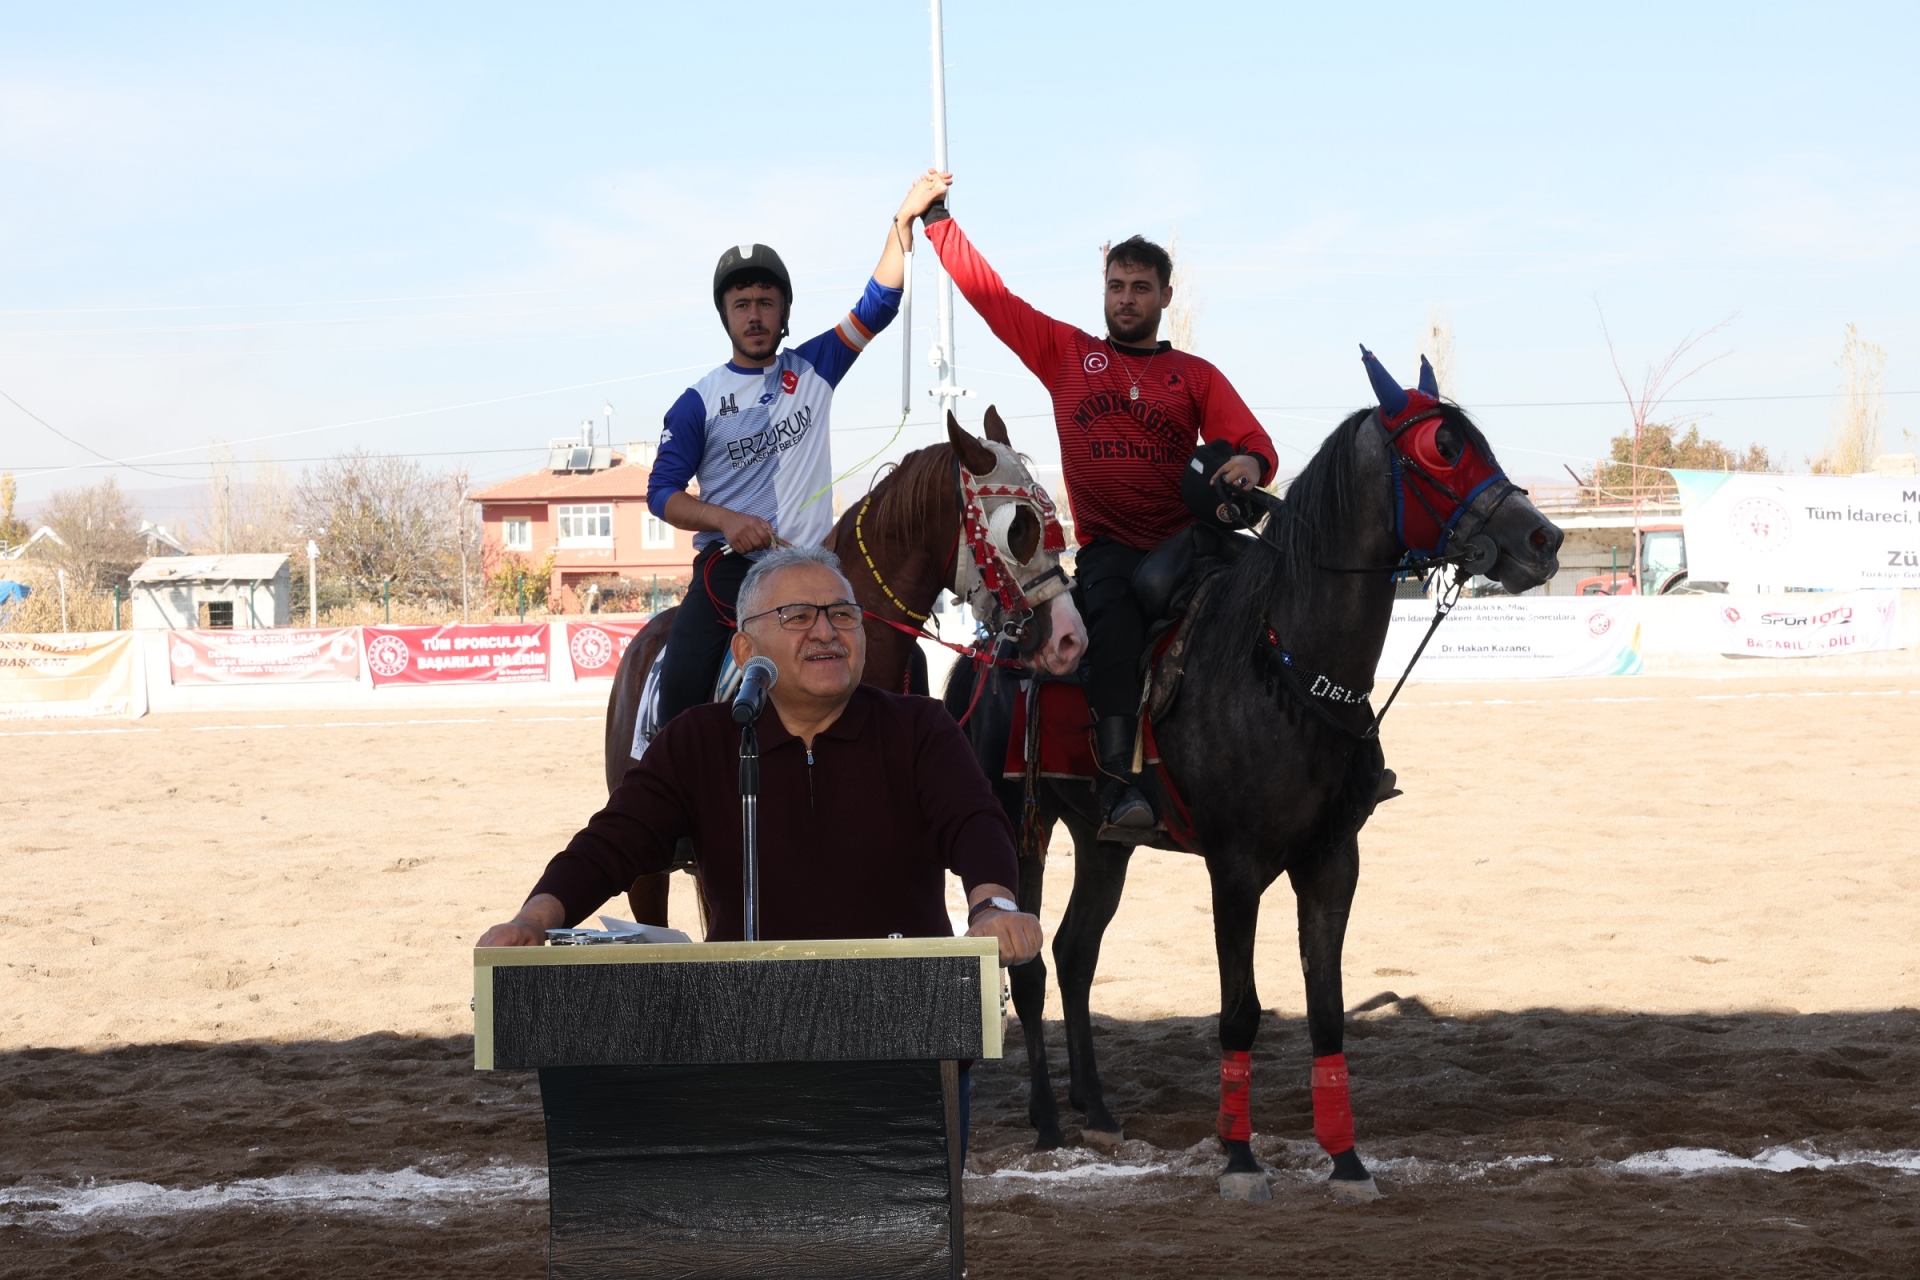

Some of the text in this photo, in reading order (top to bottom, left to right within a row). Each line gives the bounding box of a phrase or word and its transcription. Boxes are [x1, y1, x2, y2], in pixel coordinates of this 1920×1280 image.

[727, 405, 812, 461] ERZURUM
[1804, 504, 1913, 525] Tüm İdareci,
[1861, 570, 1900, 579] Türkiye
[1391, 614, 1406, 622] üm
[1476, 613, 1514, 622] Antrenör
[1528, 612, 1576, 622] Sporculara
[1760, 606, 1853, 627] SPOR TOTO
[421, 635, 540, 651] TÜM SPORCULARA
[1457, 644, 1489, 652] Hakan
[1491, 644, 1531, 652] Kazancı
[417, 651, 546, 671] BAŞARILAR DİLERİM
